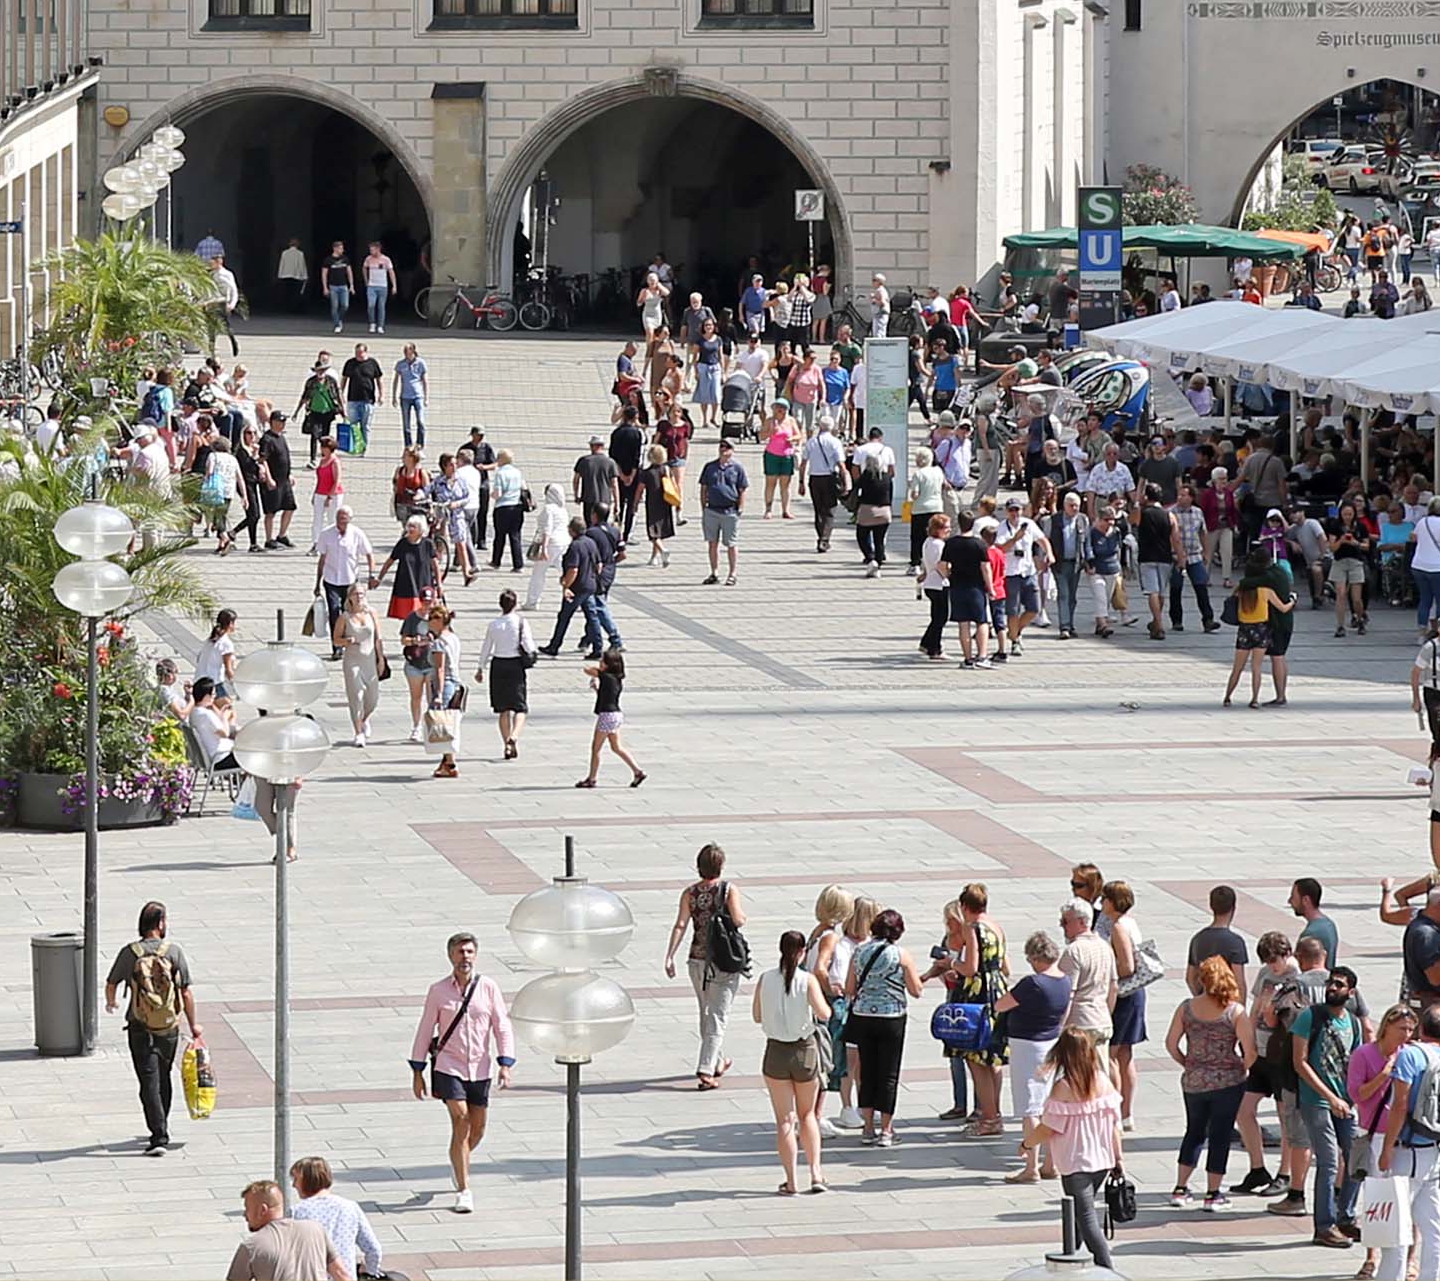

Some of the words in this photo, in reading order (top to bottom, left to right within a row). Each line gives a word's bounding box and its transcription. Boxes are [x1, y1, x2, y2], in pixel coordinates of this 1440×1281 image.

[1088, 193, 1114, 224] S
[1088, 235, 1112, 266] U
[1365, 1202, 1392, 1223] H&M
